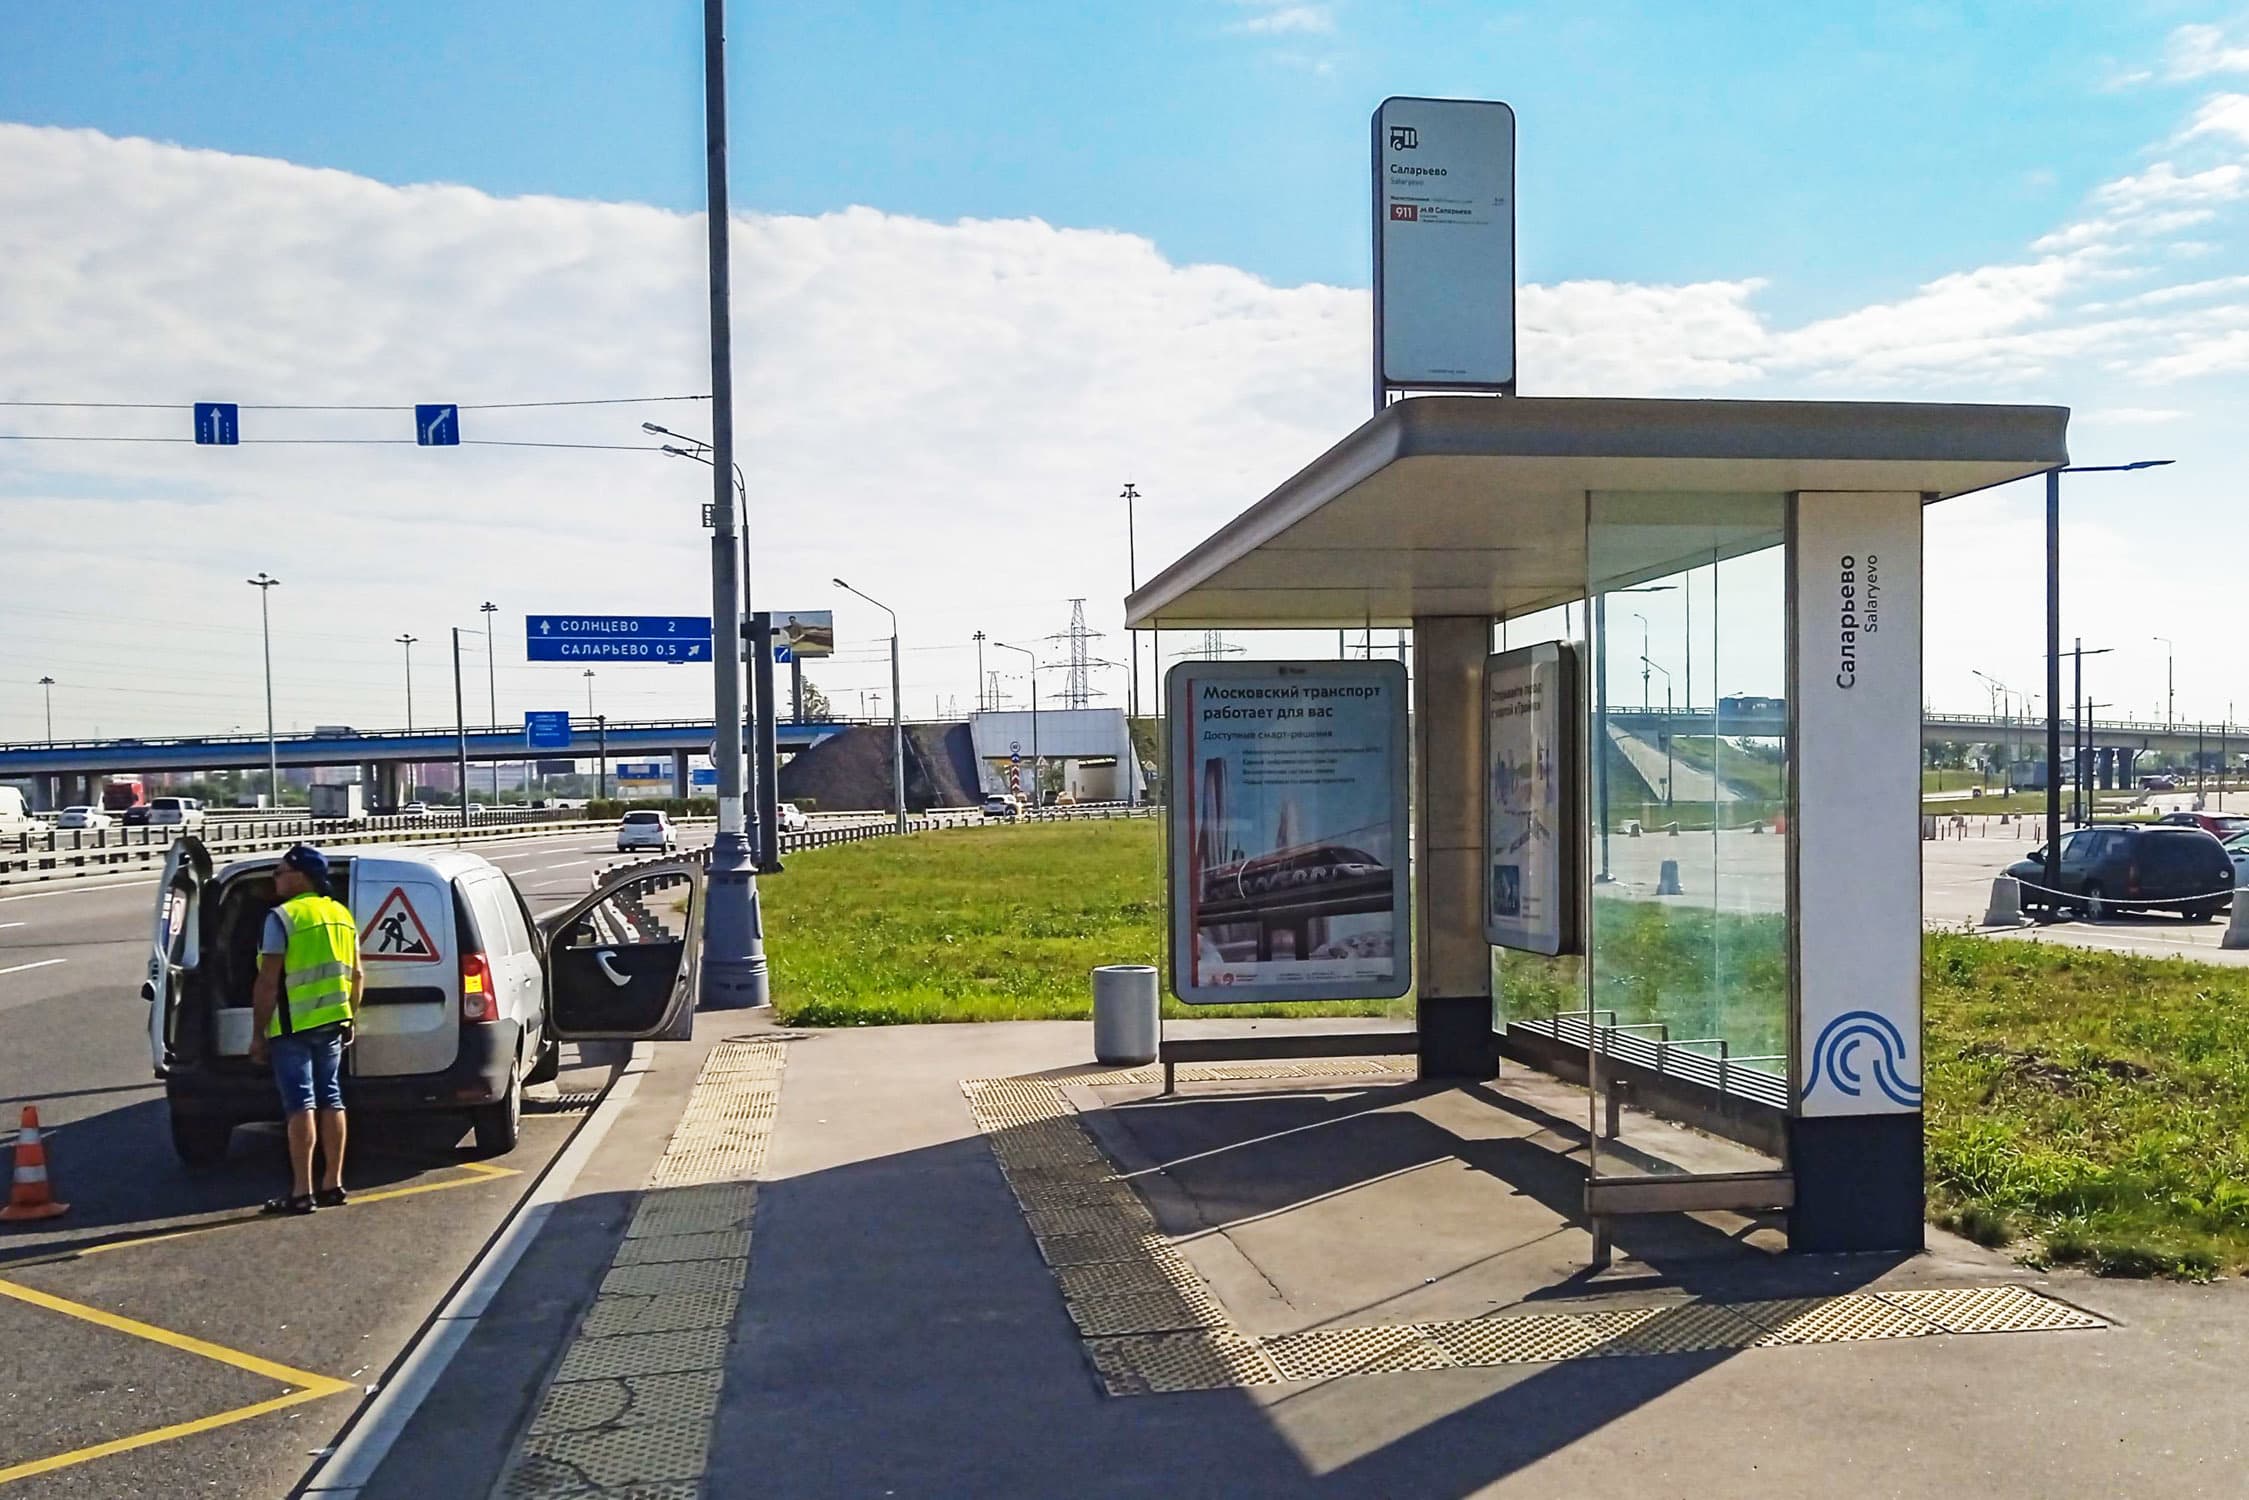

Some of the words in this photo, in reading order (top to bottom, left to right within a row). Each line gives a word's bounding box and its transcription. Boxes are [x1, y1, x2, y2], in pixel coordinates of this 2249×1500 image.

[1390, 164, 1448, 176] Саларьево
[1395, 206, 1413, 219] 911
[1864, 554, 1881, 633] Salaryevo
[560, 620, 639, 633] СОЛНЦЕВО
[668, 621, 676, 632] 2
[1836, 555, 1860, 690] Саларьево
[561, 644, 649, 656] САЛАРЬЕВО
[1203, 685, 1299, 700] Московский
[1303, 686, 1381, 701] транспорт
[1203, 706, 1273, 722] работает
[1277, 708, 1304, 720] для
[1308, 707, 1334, 718] вас
